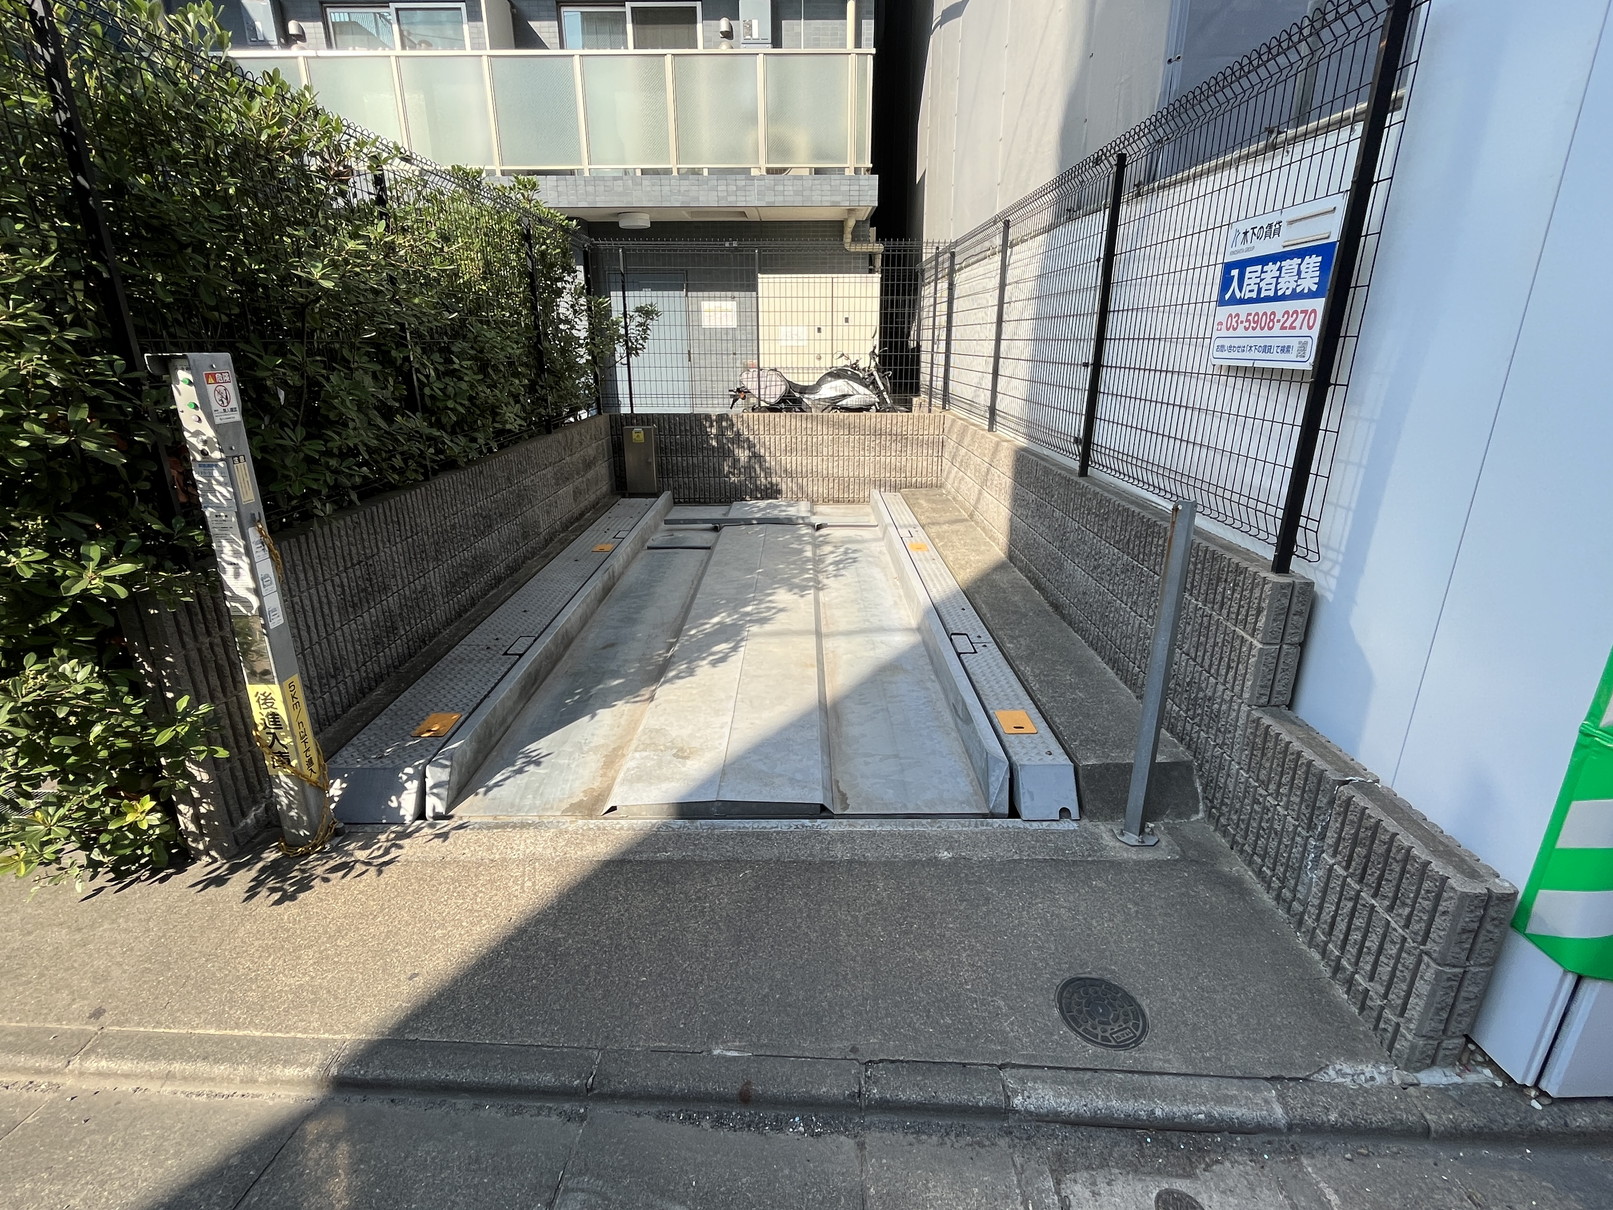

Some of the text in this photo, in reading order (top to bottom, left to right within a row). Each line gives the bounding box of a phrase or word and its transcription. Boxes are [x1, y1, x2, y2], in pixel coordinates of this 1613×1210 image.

[1240, 220, 1283, 245] 木下の賃貸
[1225, 255, 1322, 301] 入居者募集
[1226, 309, 1318, 331] 03-5908-2270
[254, 690, 291, 770] 後進入庫
